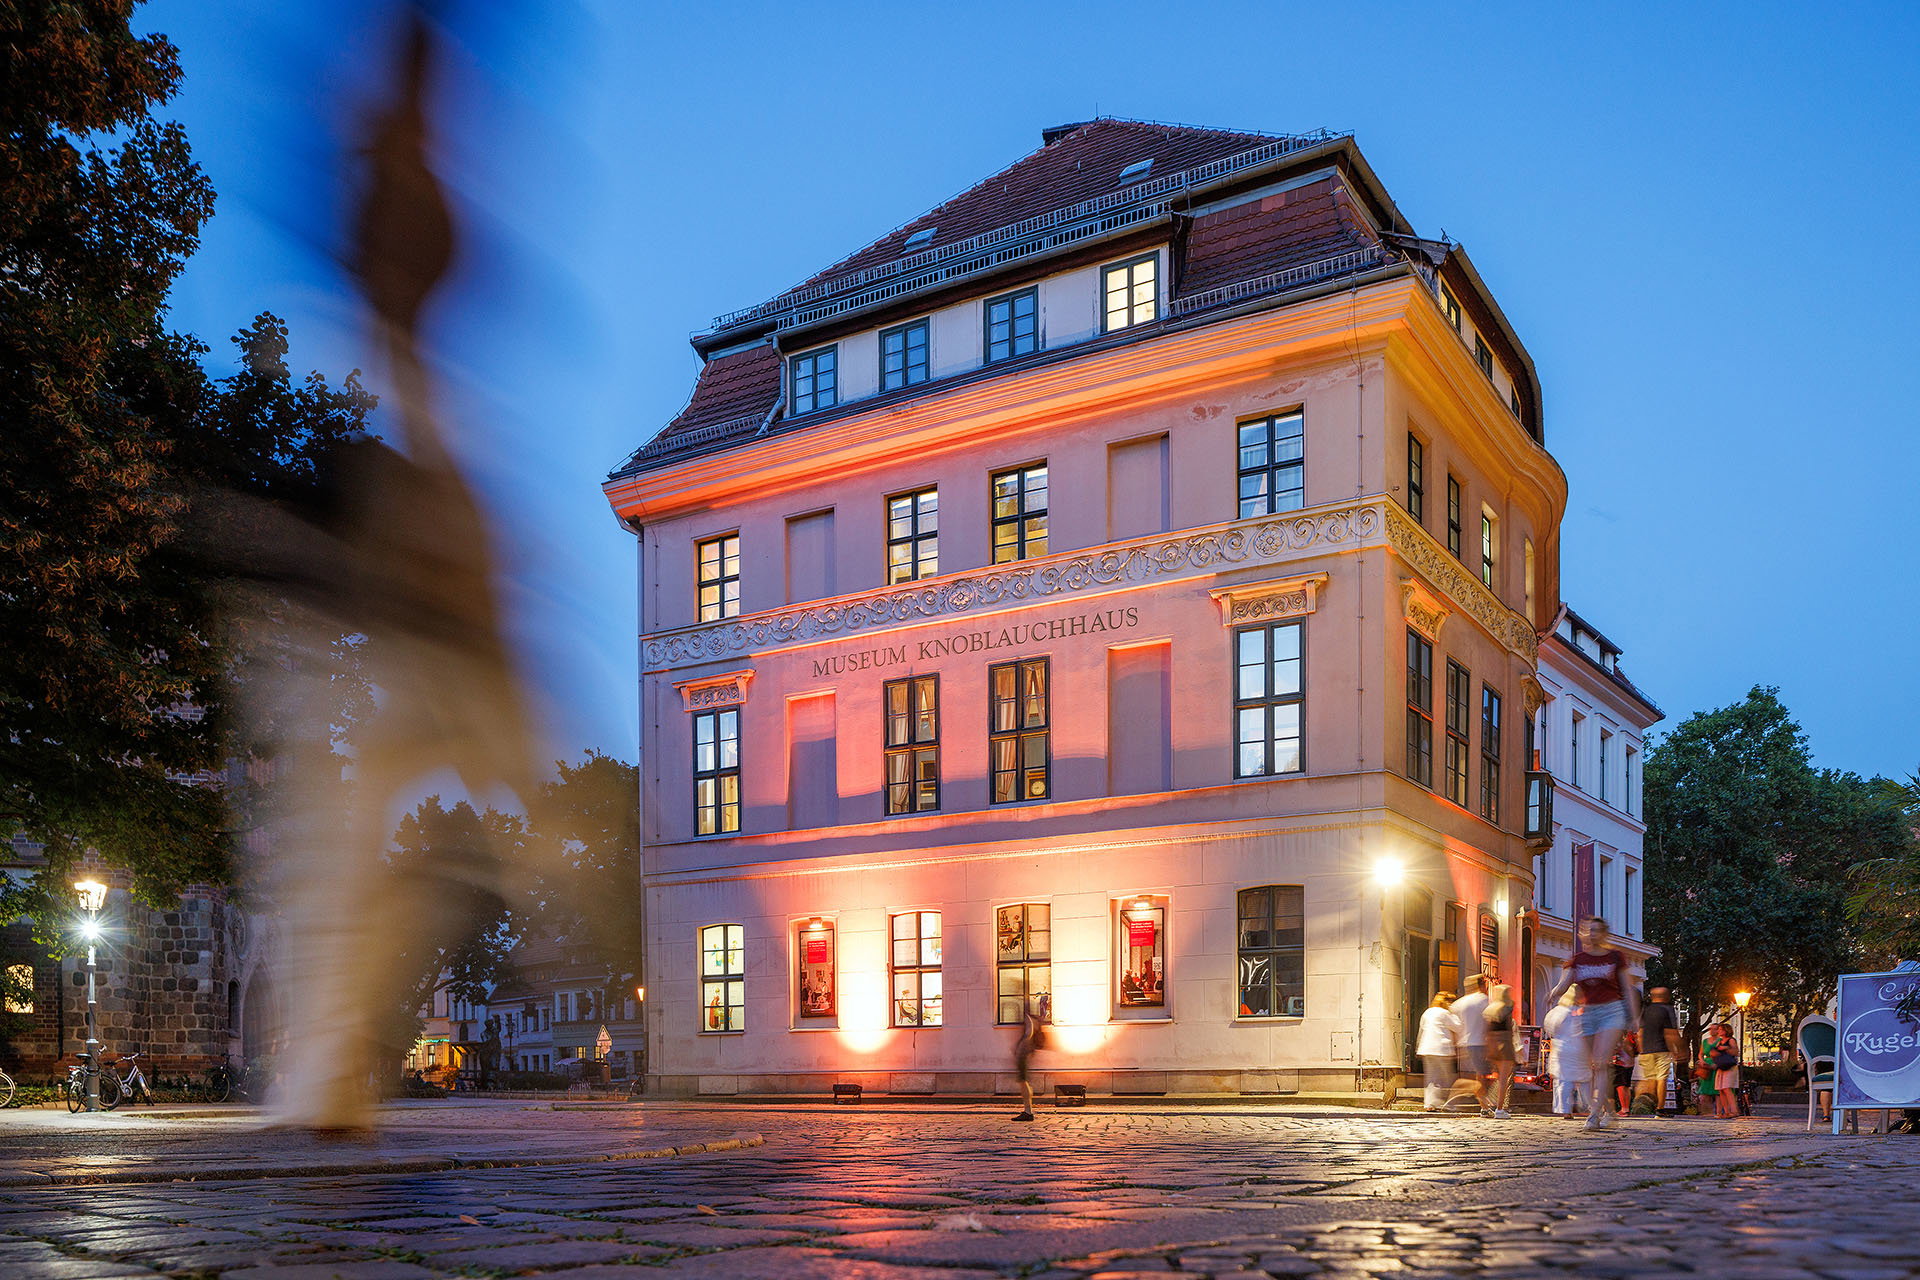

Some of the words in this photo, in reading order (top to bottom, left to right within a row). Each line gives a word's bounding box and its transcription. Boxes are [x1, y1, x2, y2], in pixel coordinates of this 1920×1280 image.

[812, 645, 906, 678] MUSEUM
[917, 607, 1139, 661] KNOBLAUCHHAUS
[1878, 982, 1920, 1009] Caf
